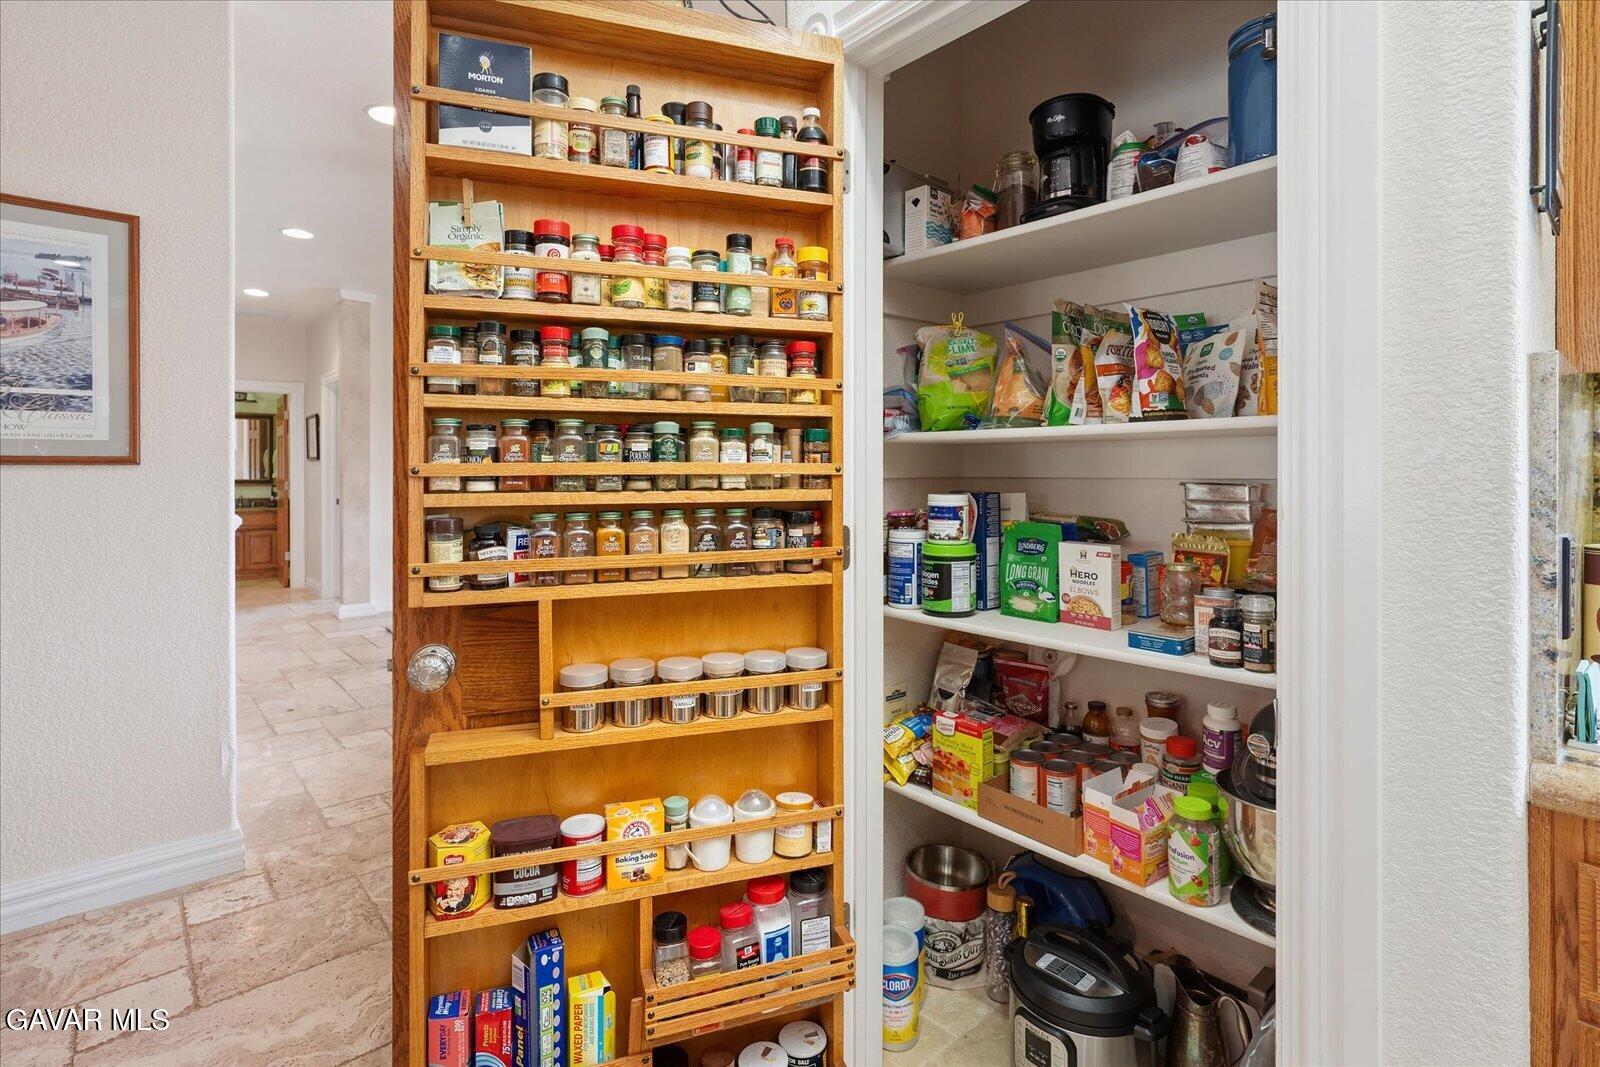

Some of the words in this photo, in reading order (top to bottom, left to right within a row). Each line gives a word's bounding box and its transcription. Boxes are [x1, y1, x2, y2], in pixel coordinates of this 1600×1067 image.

[468, 72, 504, 84] MORTON
[474, 86, 496, 94] COARSE
[930, 201, 943, 210] Kosher
[450, 224, 482, 234] Simply
[951, 344, 976, 354] LIME
[1188, 372, 1209, 380] Almonds
[630, 450, 651, 460] POULTRY
[518, 538, 529, 546] RE
[1017, 542, 1045, 552] LUNDBERG
[1006, 564, 1027, 582] LONG
[1028, 565, 1049, 588] GRAIN
[1070, 569, 1098, 580] HERO
[1016, 582, 1038, 590] ORGANIC
[1070, 586, 1100, 596] ELBOWS
[615, 854, 640, 863] Baking
[640, 852, 657, 860] Soda
[1170, 856, 1189, 866] alcium
[514, 865, 540, 879] COCOA
[883, 979, 910, 991] CLOROX
[435, 995, 445, 1015] Reynolds
[574, 1003, 582, 1030] PAPER
[502, 1046, 510, 1055] 75
[516, 1025, 524, 1067] Panel
[574, 1034, 582, 1064] WAXED
